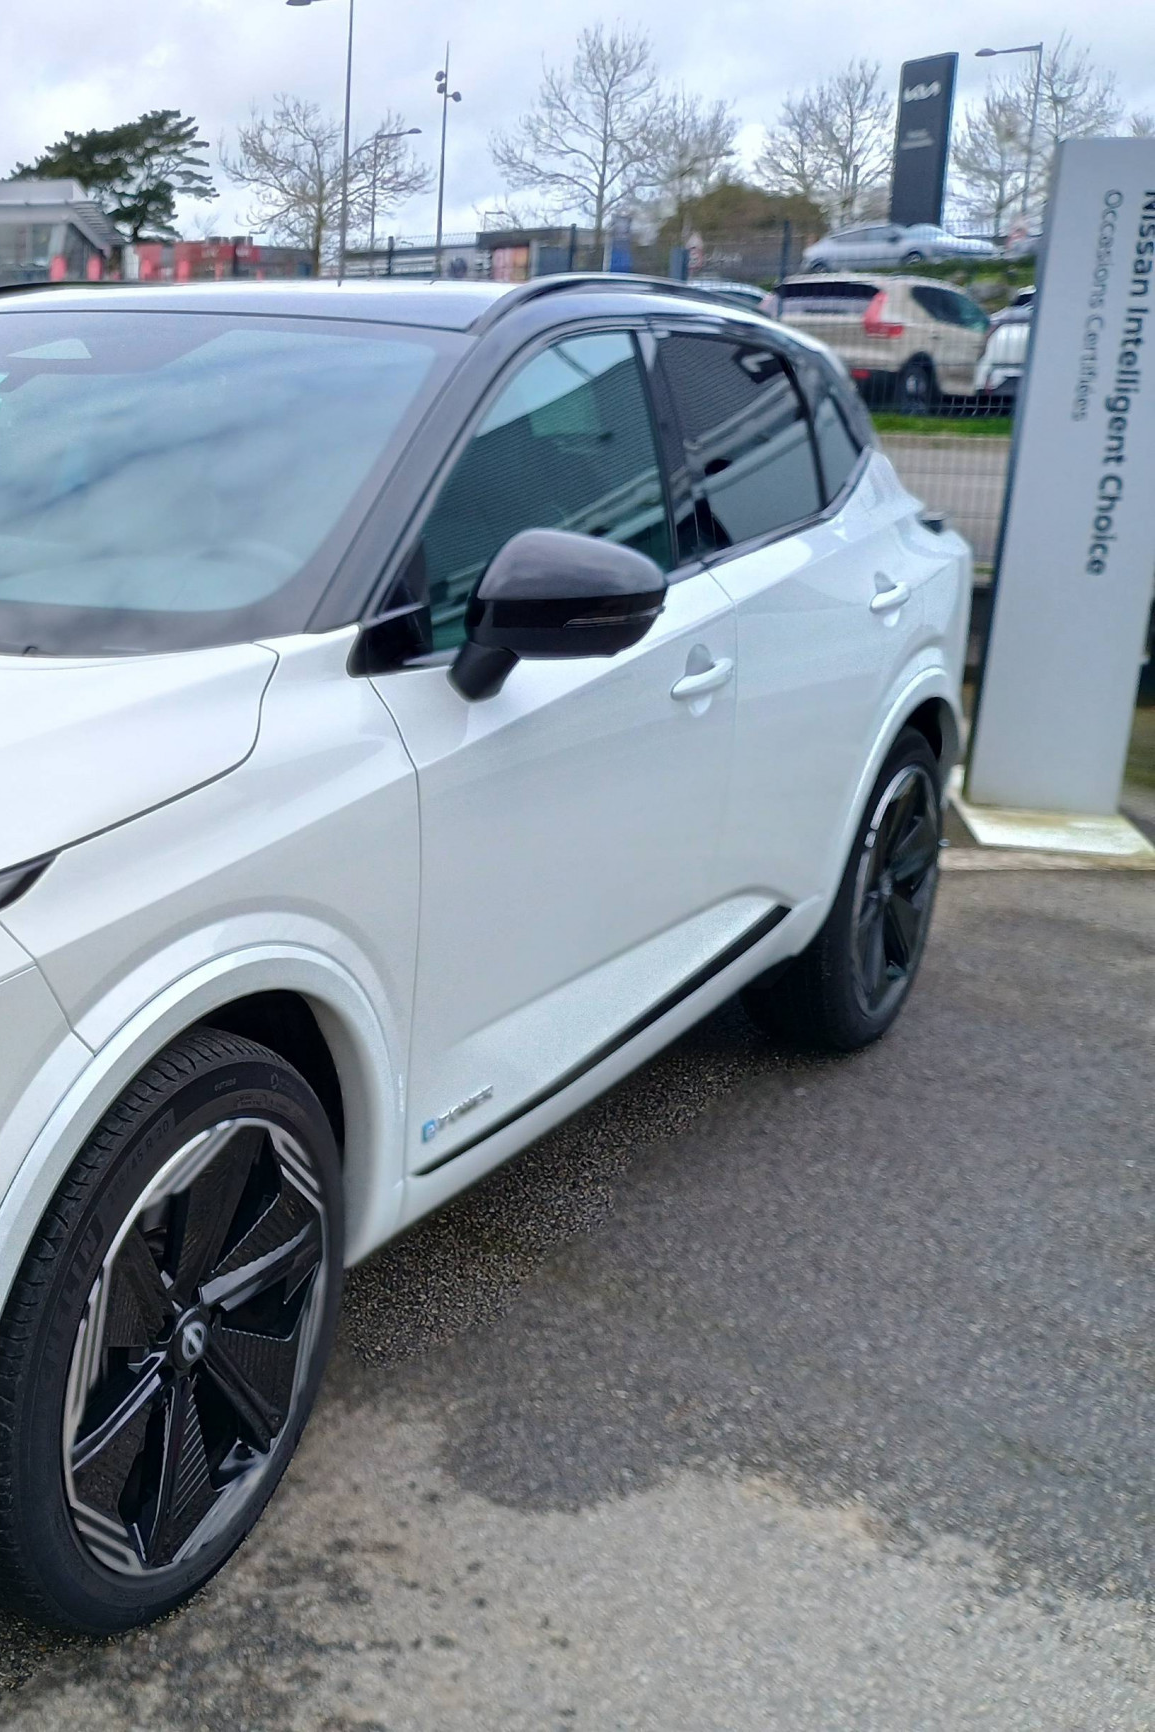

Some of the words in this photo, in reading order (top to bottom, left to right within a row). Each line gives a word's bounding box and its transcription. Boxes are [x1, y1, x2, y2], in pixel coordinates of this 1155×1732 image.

[1088, 189, 1123, 309] Occasions
[1103, 307, 1149, 467] Intelligent
[1086, 473, 1124, 577] Choice
